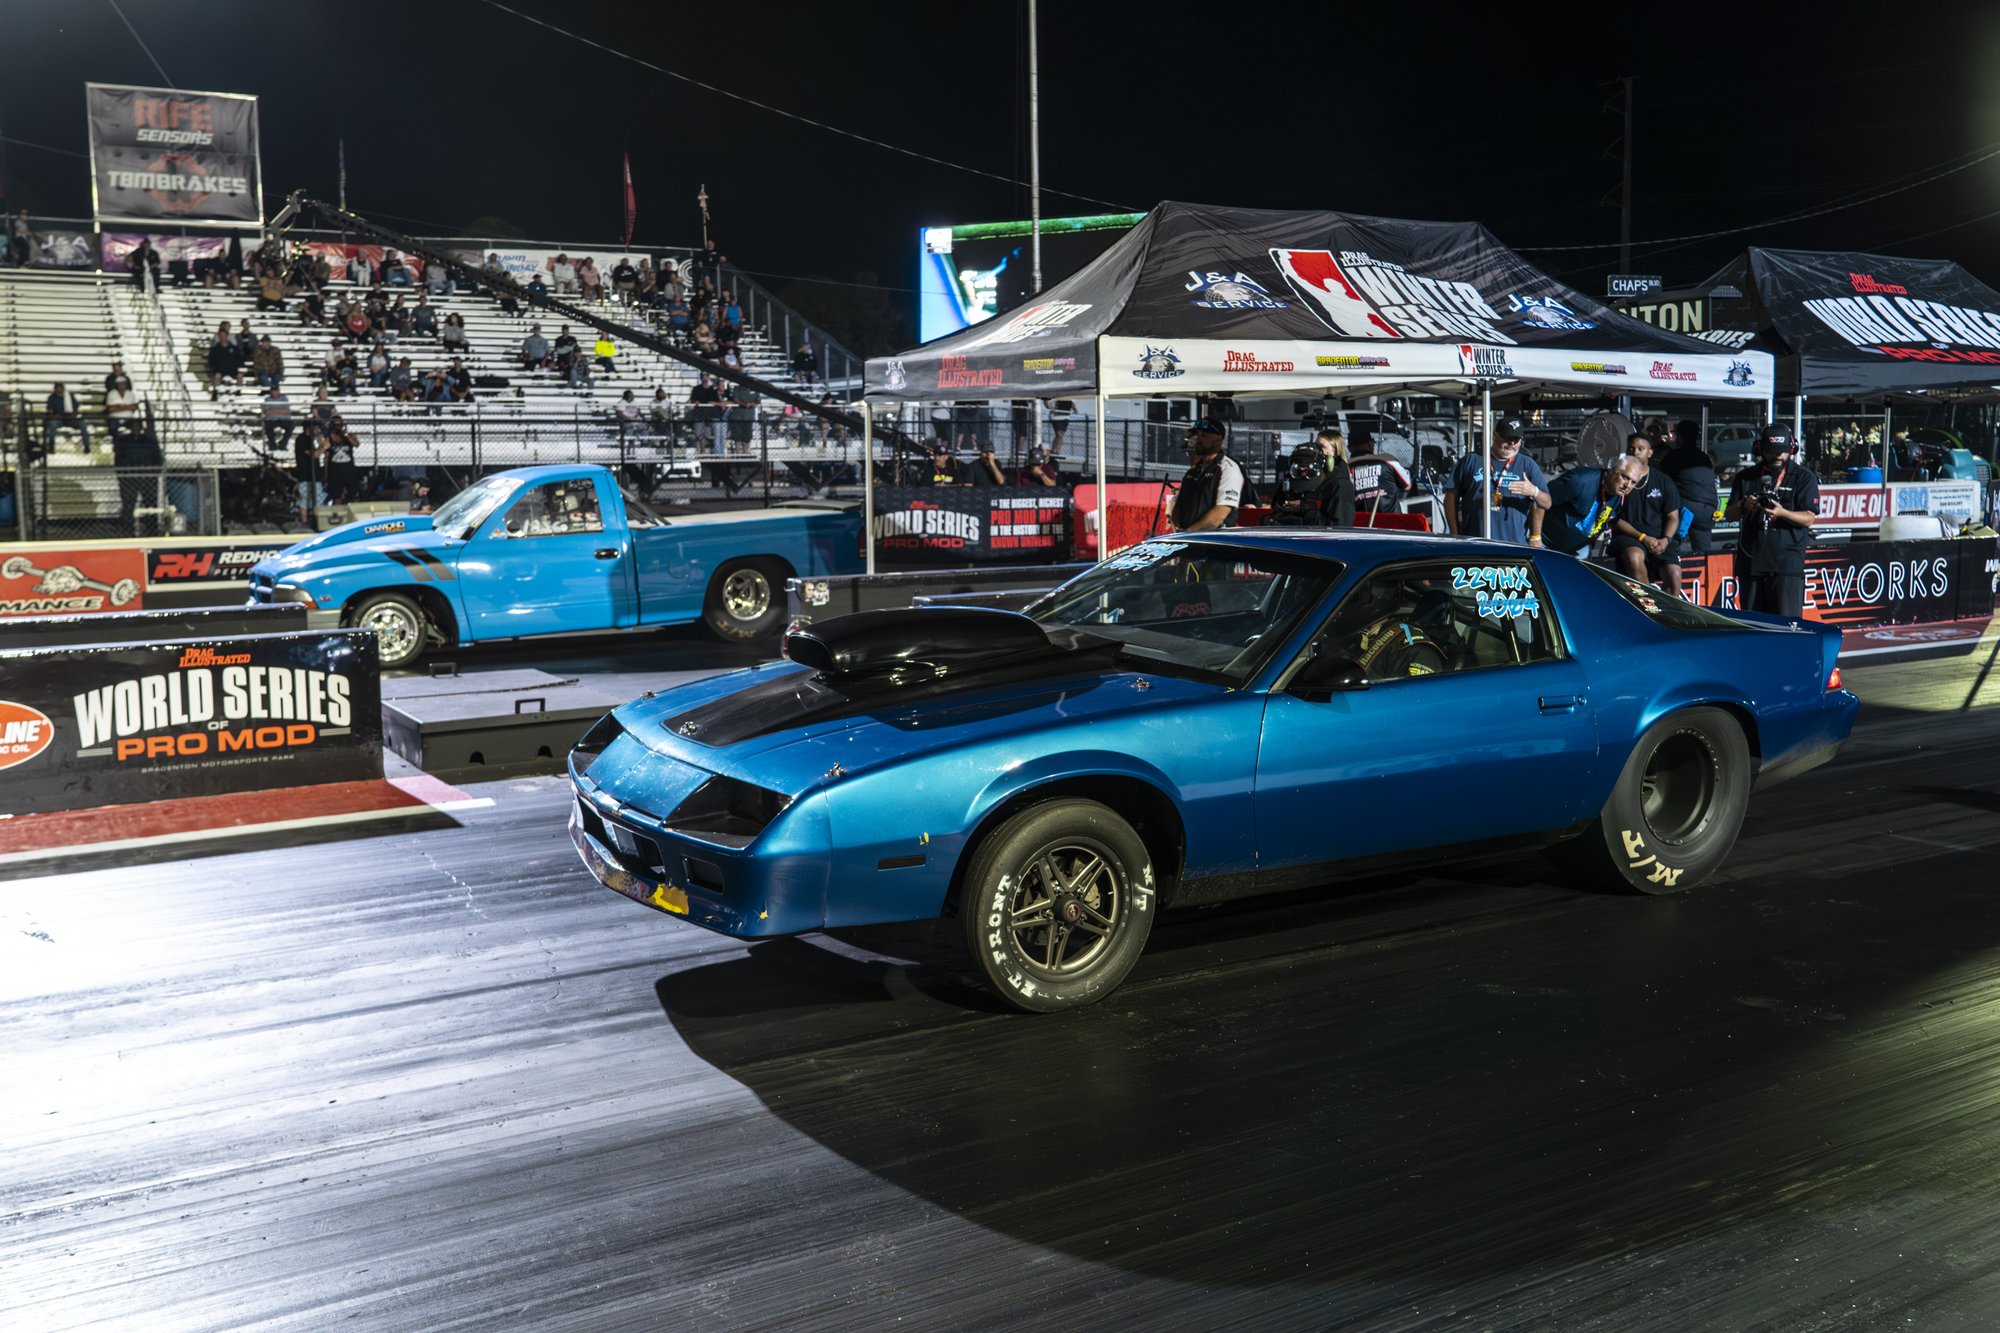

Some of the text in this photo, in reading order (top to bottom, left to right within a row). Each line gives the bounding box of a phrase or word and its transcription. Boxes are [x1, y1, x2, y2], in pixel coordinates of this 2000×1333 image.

[134, 99, 213, 131] RIFE
[136, 128, 214, 145] SENSORS
[1340, 251, 1370, 262] DRAG
[1340, 258, 1405, 273] ILLUSTRATED
[1185, 271, 1270, 294] J&A
[1612, 279, 1649, 292] CHAPS
[1849, 272, 1877, 285] DRAG
[1344, 266, 1502, 320] WINTER
[1850, 281, 1908, 295] ILLUSTRATED
[1197, 299, 1288, 310] SERVICE
[1507, 293, 1576, 318] J&A
[1380, 304, 1518, 345] SERIES
[1523, 321, 1598, 330] SERVICE
[1802, 295, 1928, 346] WORLD
[1138, 344, 1180, 361] J&A
[1226, 350, 1256, 362] DRAG
[1473, 348, 1506, 365] WINTER
[1877, 346, 1961, 361] PRO
[886, 360, 906, 376] J&A
[942, 355, 967, 370] DRAG
[1223, 361, 1295, 372] ILLUSTRATED
[1316, 355, 1360, 367] BRADENTON
[1652, 360, 1673, 372] DRAG
[1135, 370, 1182, 379] SERVICE
[1476, 364, 1504, 376] SERIES
[1649, 371, 1697, 381] ILLUSTRATED
[937, 368, 1003, 388] ILLUSTRATED
[1355, 465, 1382, 480] WINTER
[1355, 475, 1379, 491] SERIES
[1837, 495, 1869, 517] LINE
[991, 510, 1011, 525] PRO
[1014, 509, 1037, 524] MOD
[364, 521, 405, 534] DIAMOND
[873, 509, 980, 541] WORLD SERIES
[884, 537, 965, 548] PRO MOD
[153, 552, 214, 578] RH
[1451, 566, 1532, 591] 229HX
[179, 654, 251, 668] ILLUSTRATED
[185, 647, 215, 660] DRAG
[73, 666, 352, 749] WORLD SERIES
[207, 720, 229, 731] OF
[11, 744, 31, 754] OIL
[117, 724, 316, 761] PRO MOD
[141, 754, 295, 774] BRADENTON MOTORSPORTS PARK
[1621, 829, 1684, 887] M/T
[1132, 863, 1155, 911] M/T
[988, 874, 1012, 966] FRONT
